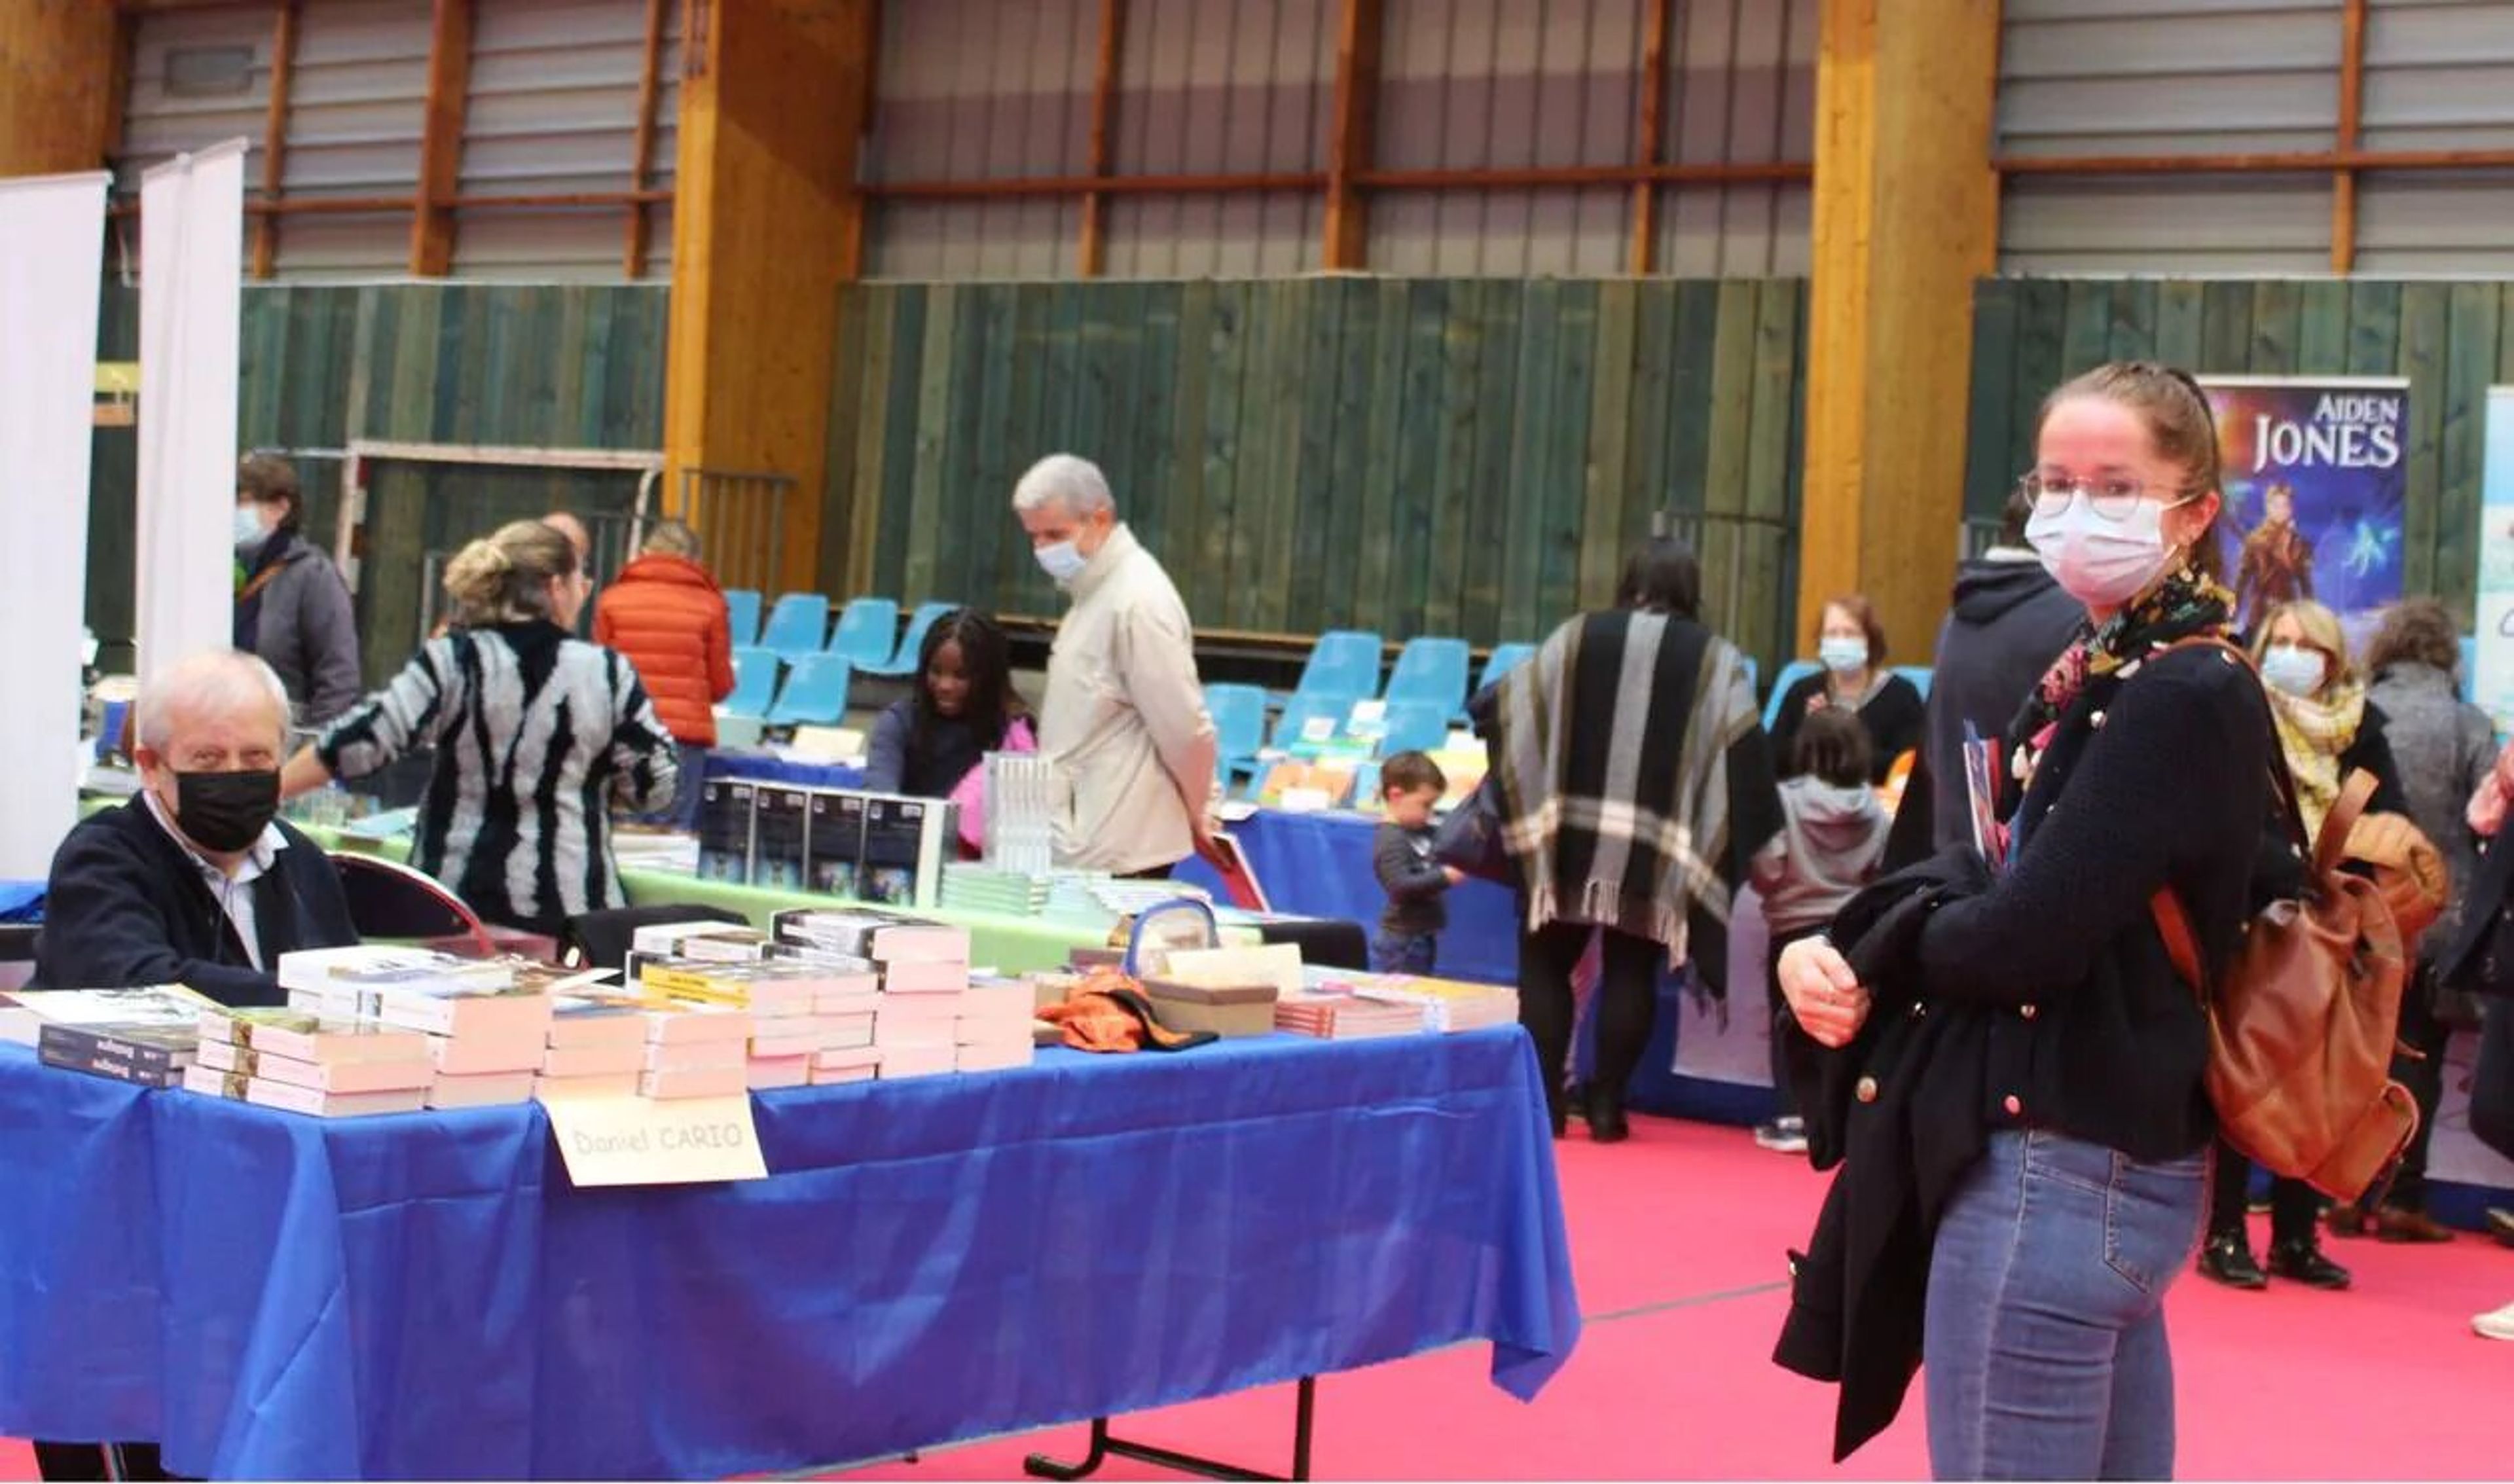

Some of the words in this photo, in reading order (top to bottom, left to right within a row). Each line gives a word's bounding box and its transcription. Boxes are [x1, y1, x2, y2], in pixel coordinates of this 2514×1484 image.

[2314, 393, 2399, 424] AIDEN
[2252, 414, 2400, 473] JONES
[573, 1126, 650, 1155] Daniel
[658, 1122, 744, 1151] CARIO
